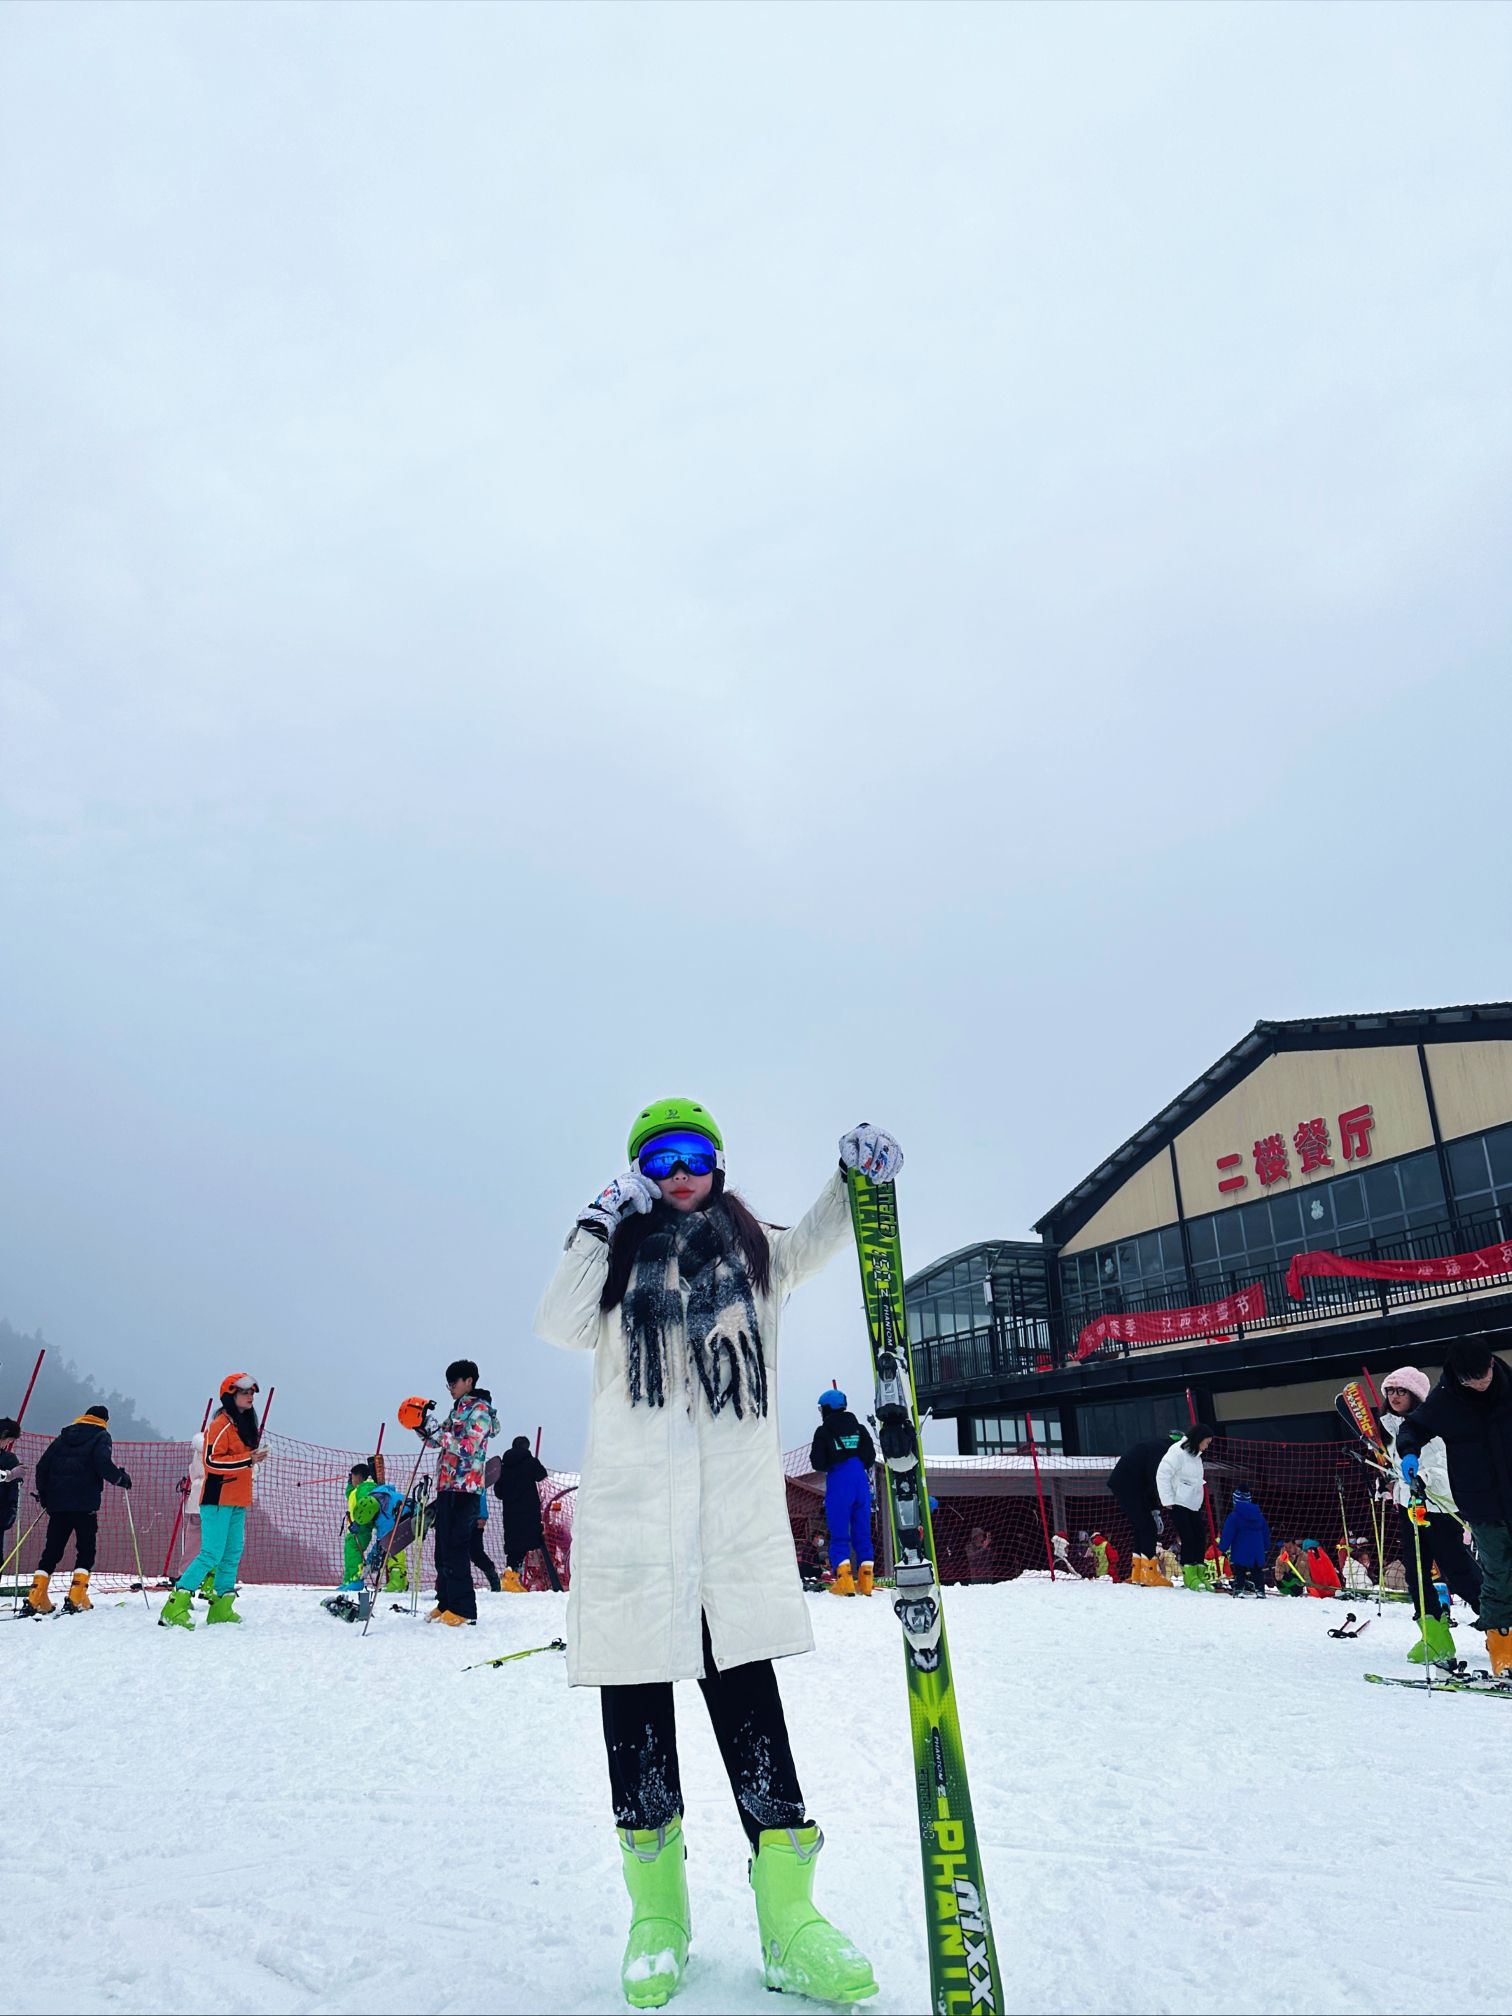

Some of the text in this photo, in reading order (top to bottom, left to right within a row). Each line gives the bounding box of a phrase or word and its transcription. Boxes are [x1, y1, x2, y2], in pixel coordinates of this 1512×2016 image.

[1217, 1104, 1374, 1193] 二楼餐厅
[882, 1305, 893, 1347] PHANTOM
[933, 1735, 944, 1781] PHANTOM
